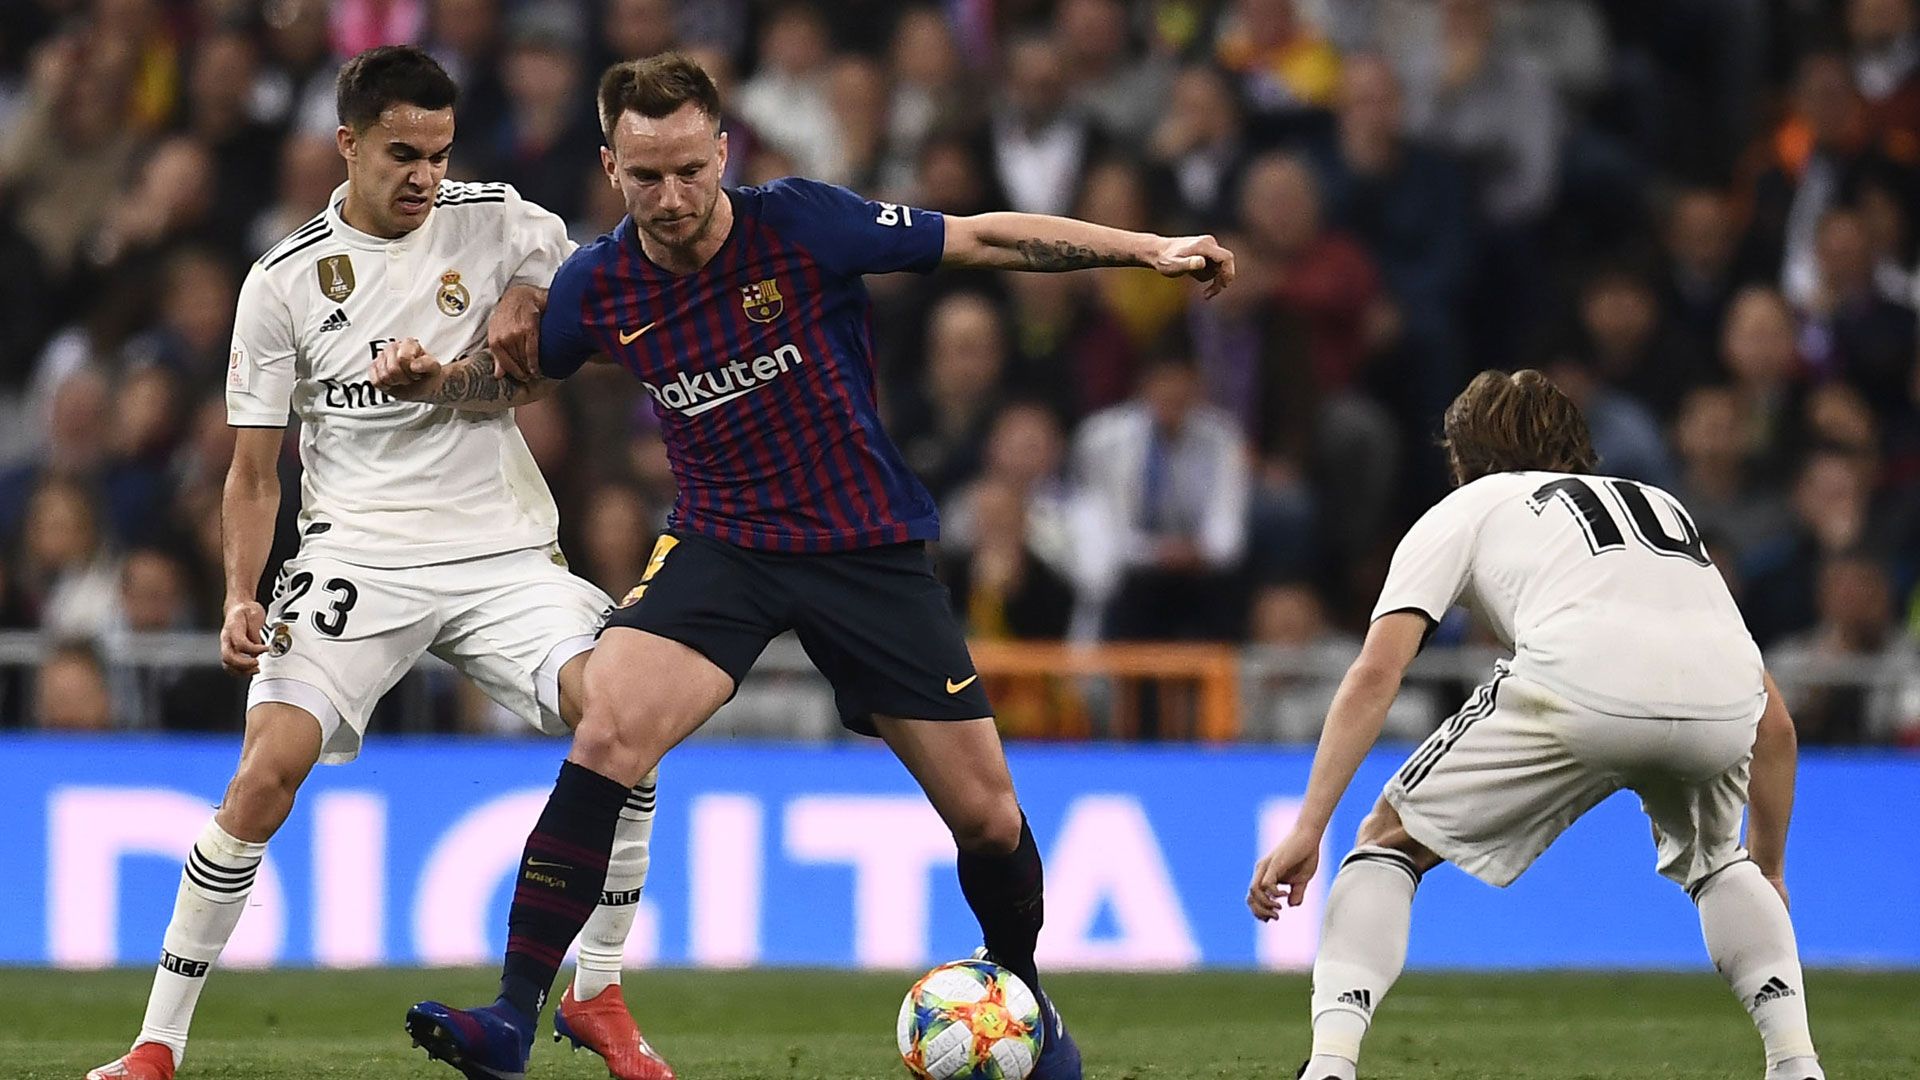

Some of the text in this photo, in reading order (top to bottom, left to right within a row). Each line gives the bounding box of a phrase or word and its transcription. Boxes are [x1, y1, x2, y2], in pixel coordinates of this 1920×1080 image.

[639, 344, 803, 409] Rakuten
[1526, 477, 1712, 567] 10
[279, 571, 358, 638] 23
